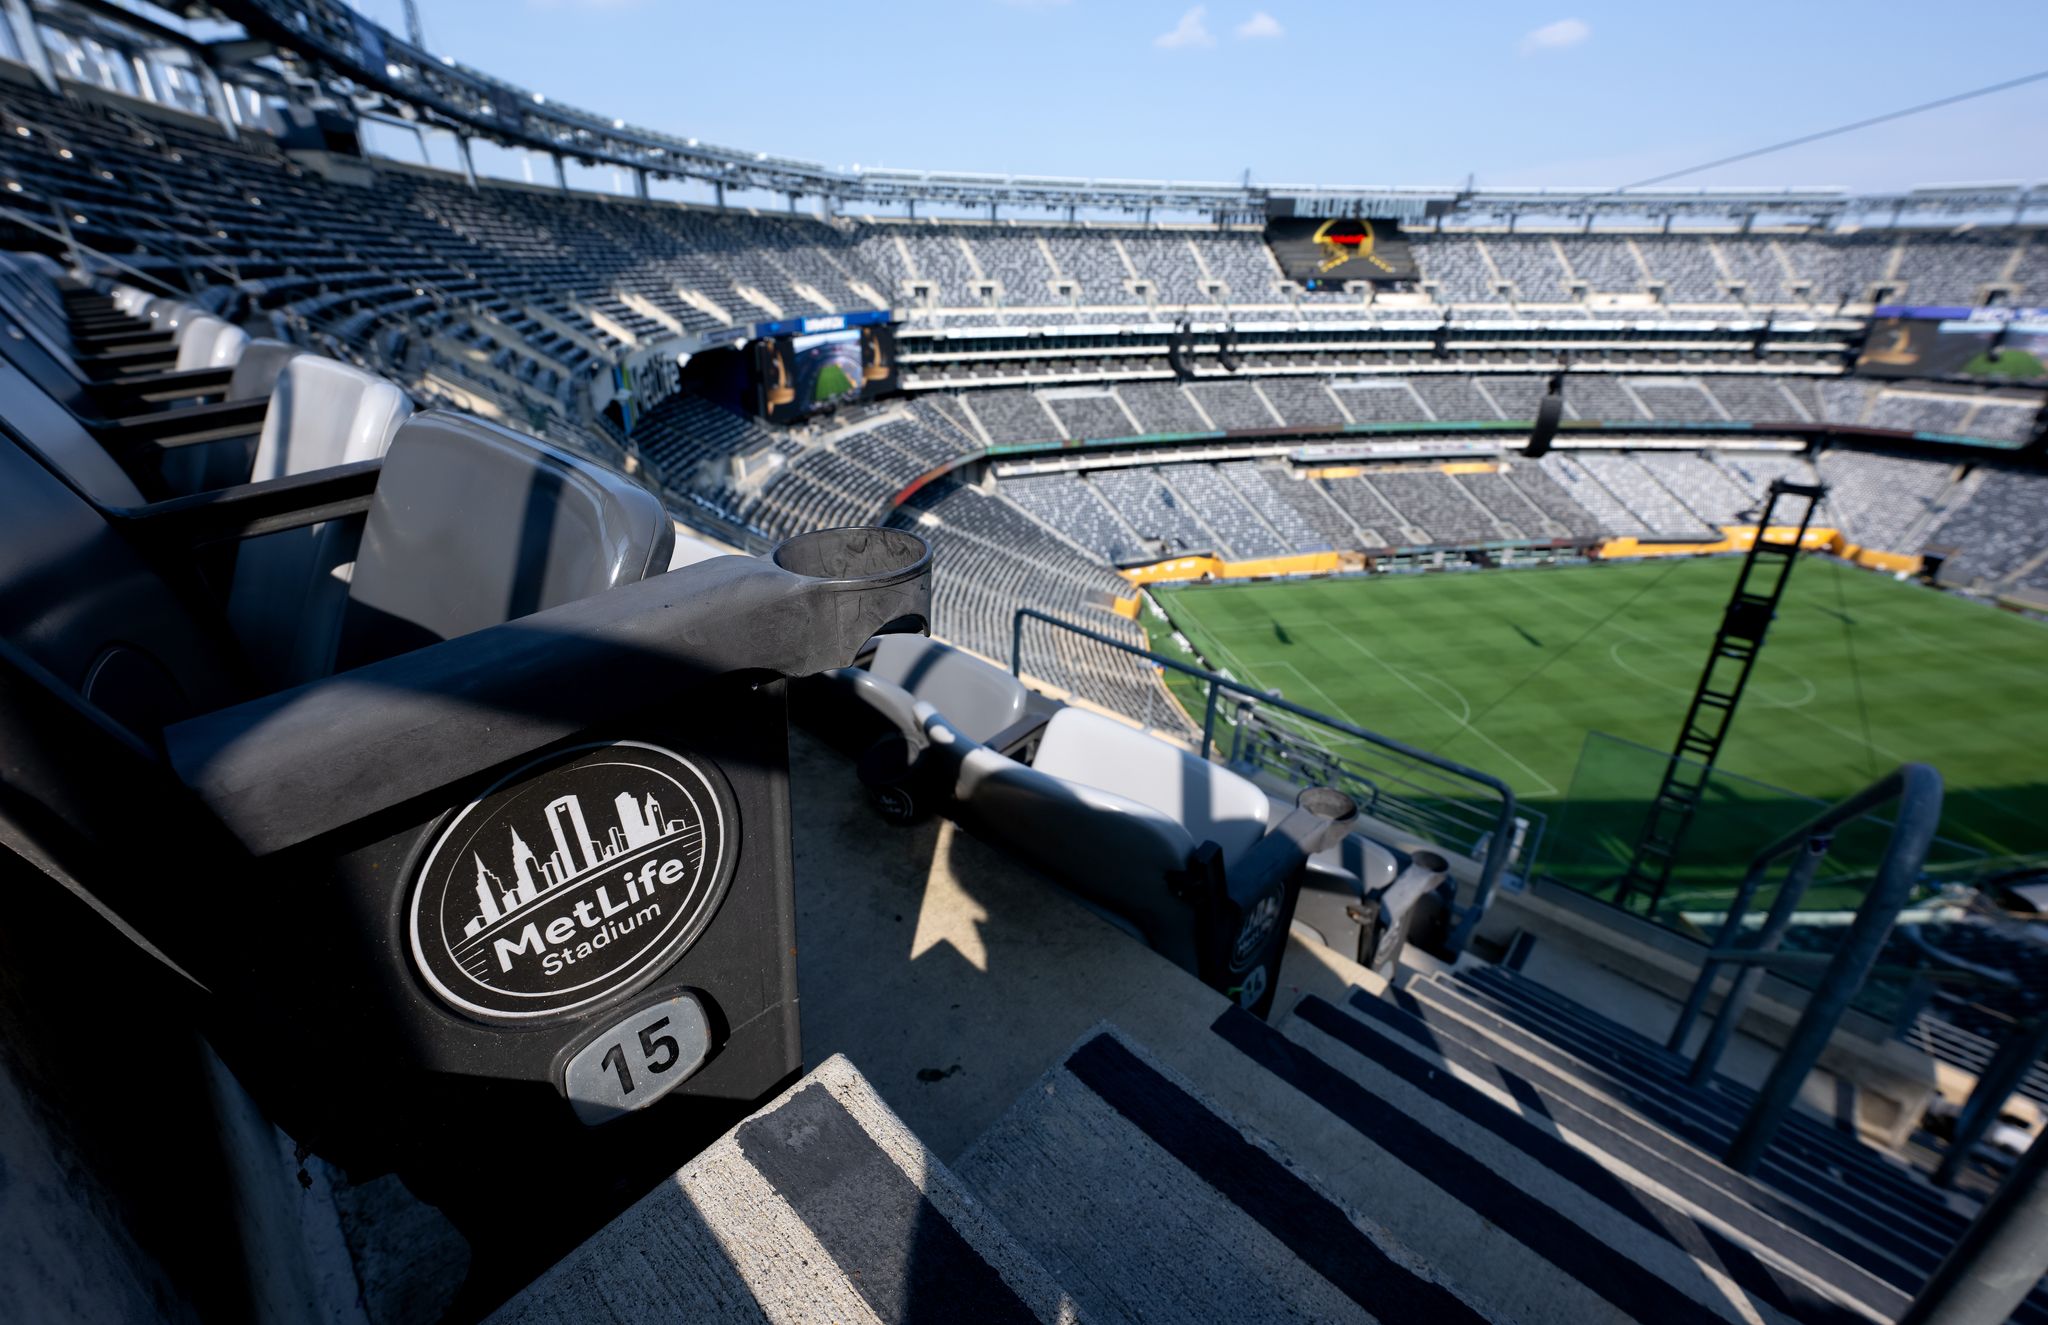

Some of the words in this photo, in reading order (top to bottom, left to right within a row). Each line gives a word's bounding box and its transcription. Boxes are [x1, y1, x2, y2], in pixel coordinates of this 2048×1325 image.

[1293, 198, 1357, 218] METLIFE
[493, 859, 685, 973] MetLife
[542, 903, 661, 975] Stadium
[600, 1016, 680, 1095] 15
